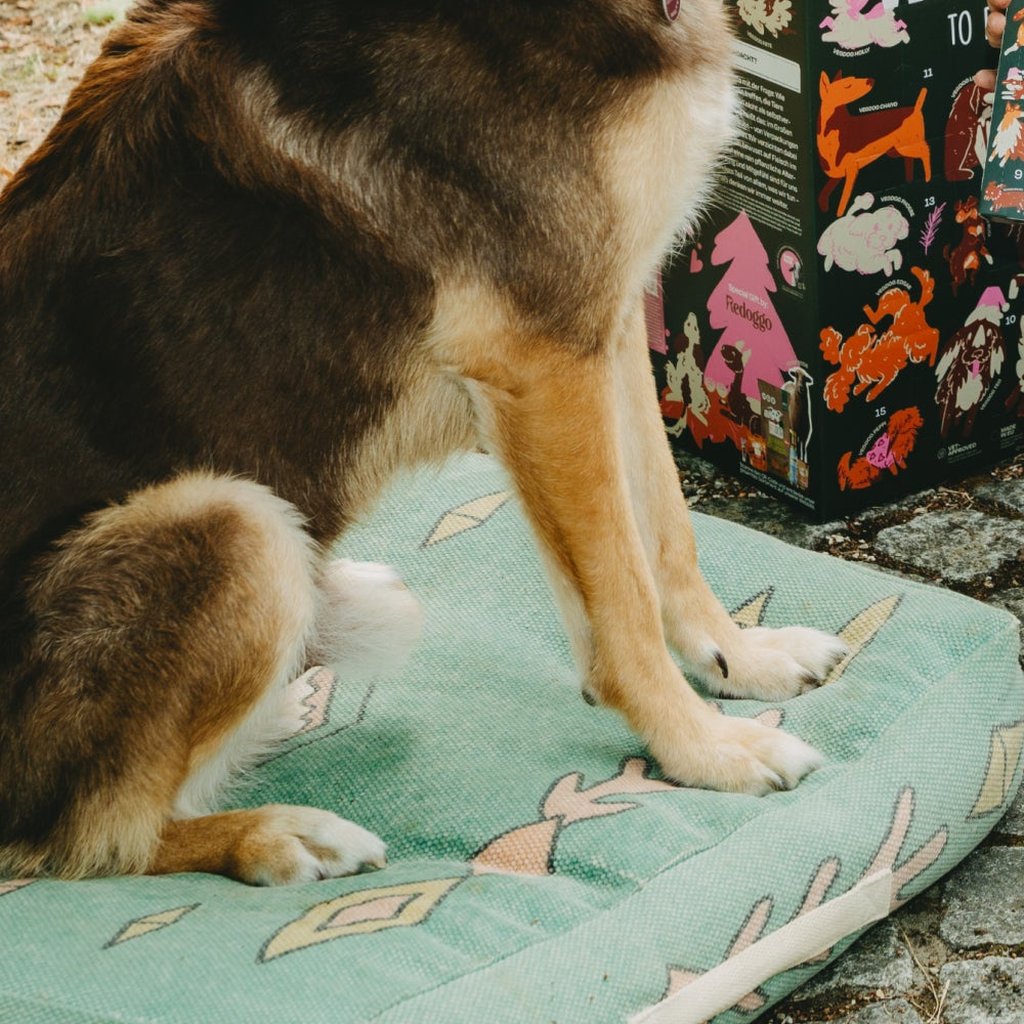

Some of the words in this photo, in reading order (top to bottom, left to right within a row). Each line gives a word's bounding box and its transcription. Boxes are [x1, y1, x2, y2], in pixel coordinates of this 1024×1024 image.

[948, 13, 972, 47] TO
[923, 68, 933, 78] 11
[1014, 169, 1022, 180] 9
[924, 196, 936, 207] 13
[726, 295, 772, 332] Redoggo
[1006, 314, 1016, 326] 10
[875, 407, 887, 418] 15
